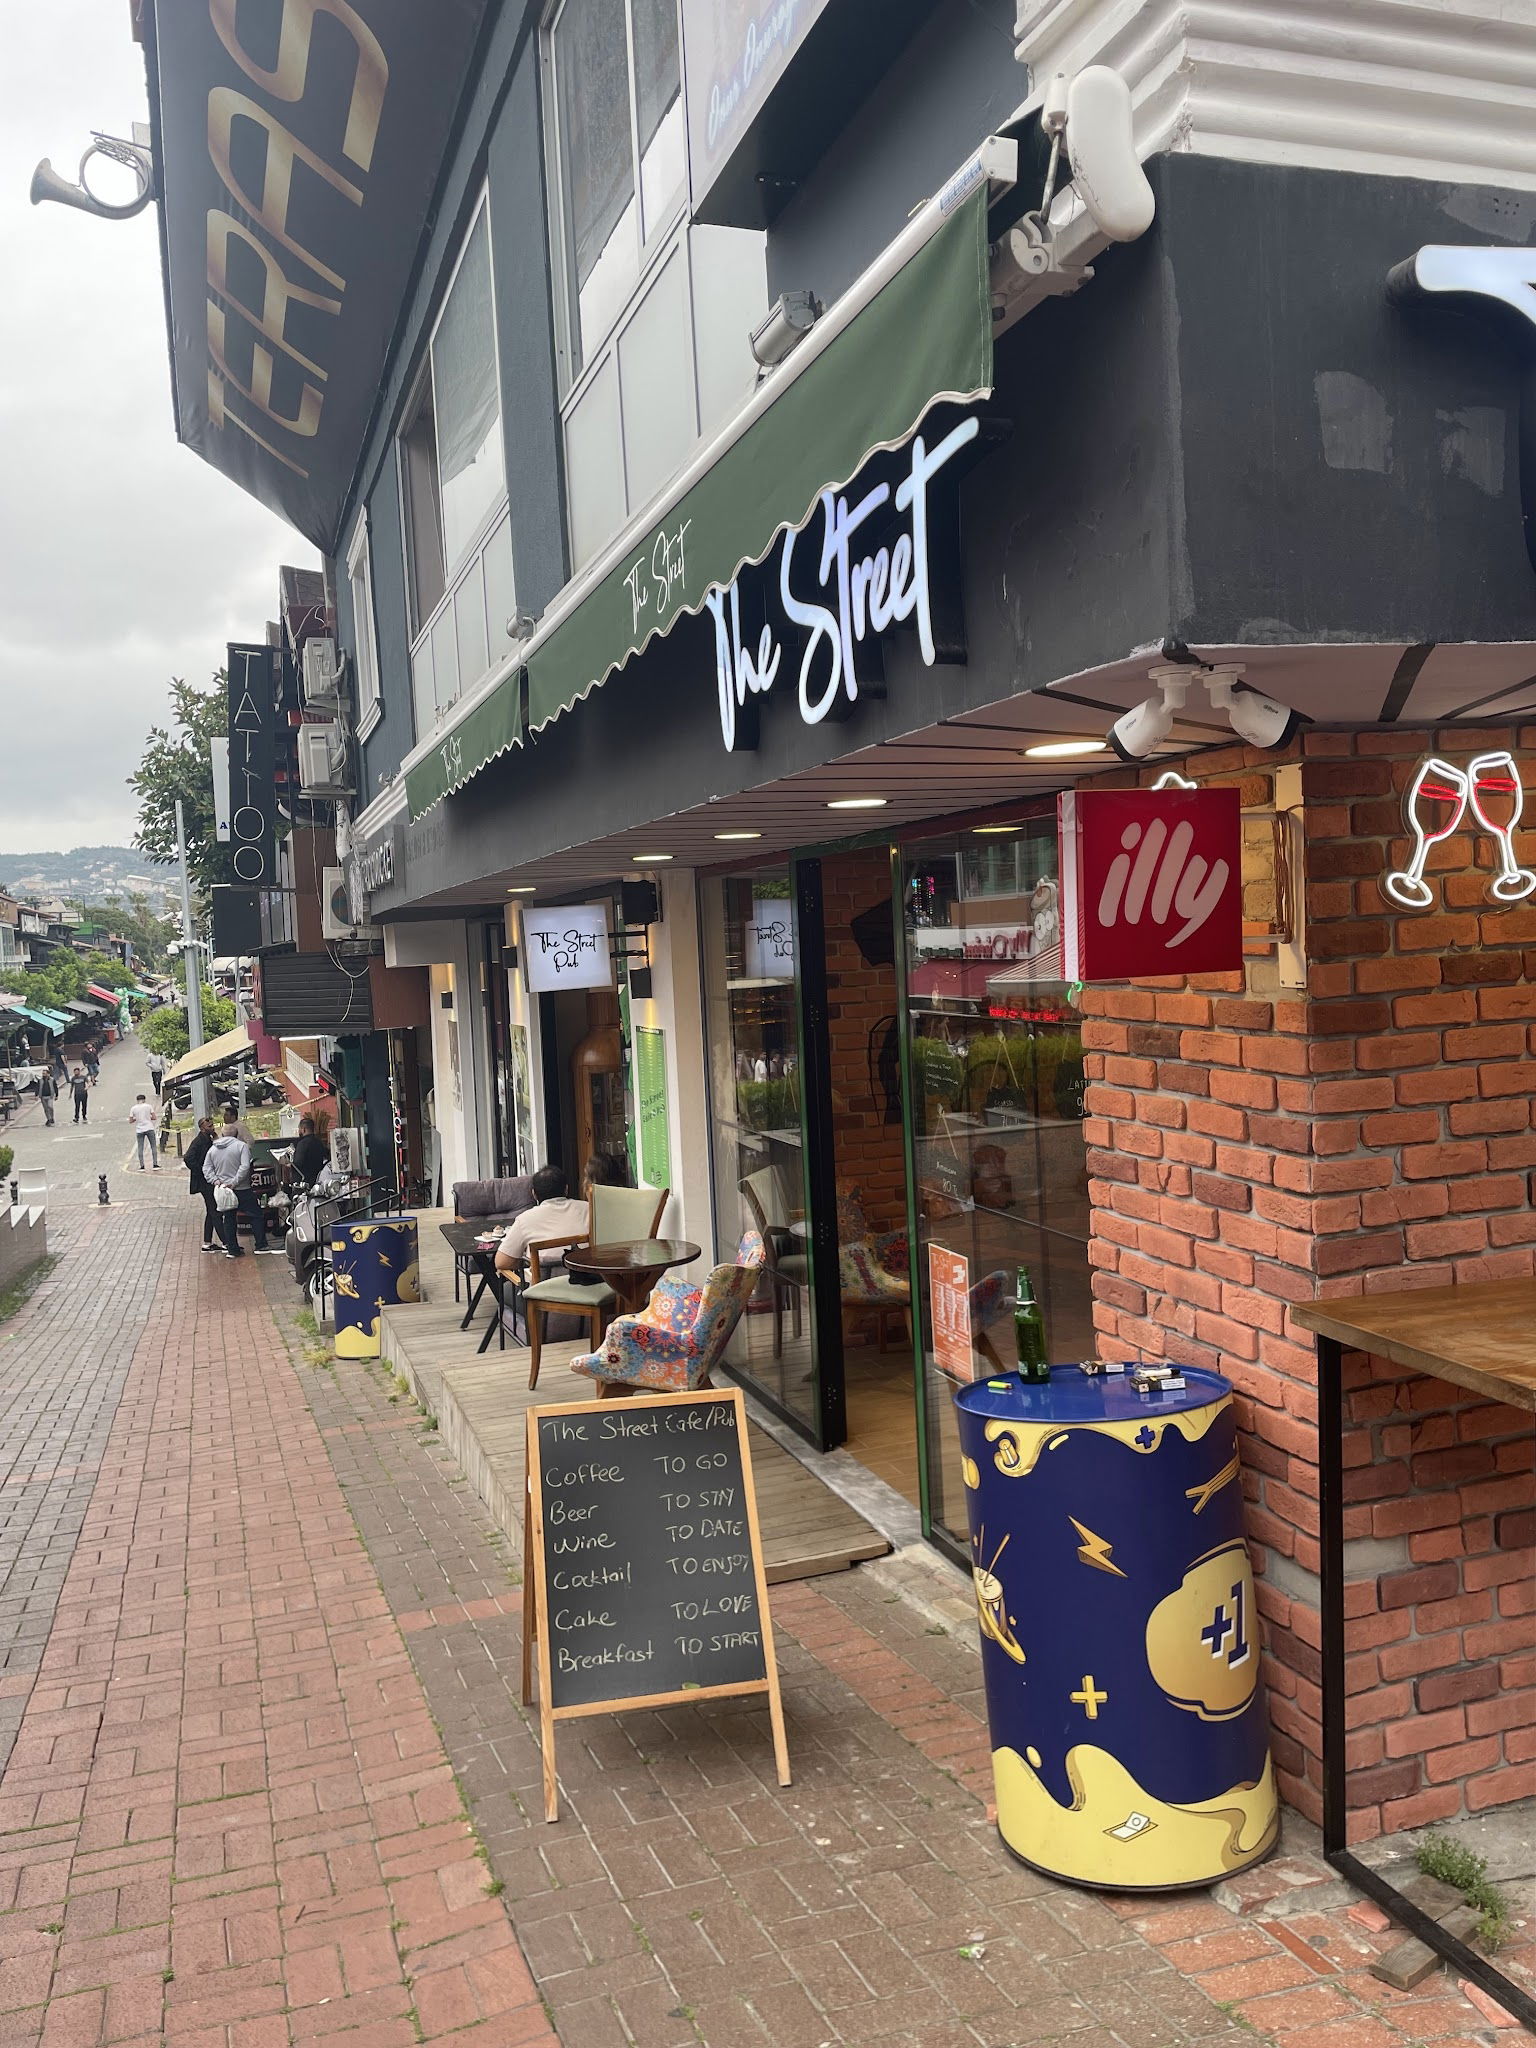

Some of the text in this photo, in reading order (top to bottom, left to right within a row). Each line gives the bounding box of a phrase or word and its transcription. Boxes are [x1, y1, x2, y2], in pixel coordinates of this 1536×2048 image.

[206, 0, 389, 478] TERAS
[623, 518, 693, 635] The Street
[705, 416, 980, 752] The Street
[233, 650, 266, 880] TATTOO
[1098, 817, 1230, 948] illy
[530, 929, 605, 954] The Street
[553, 950, 579, 973] Pub
[543, 1419, 589, 1443] The
[600, 1414, 659, 1440] Street
[545, 1452, 728, 1489] Coffee TO GO
[549, 1488, 735, 1525] Beer TO STAY
[553, 1519, 744, 1554] Wine TO DATE
[553, 1553, 750, 1590] Cocktail TO ENJOY
[555, 1608, 617, 1632] Cake
[558, 1631, 760, 1673] Breakfast TO START
